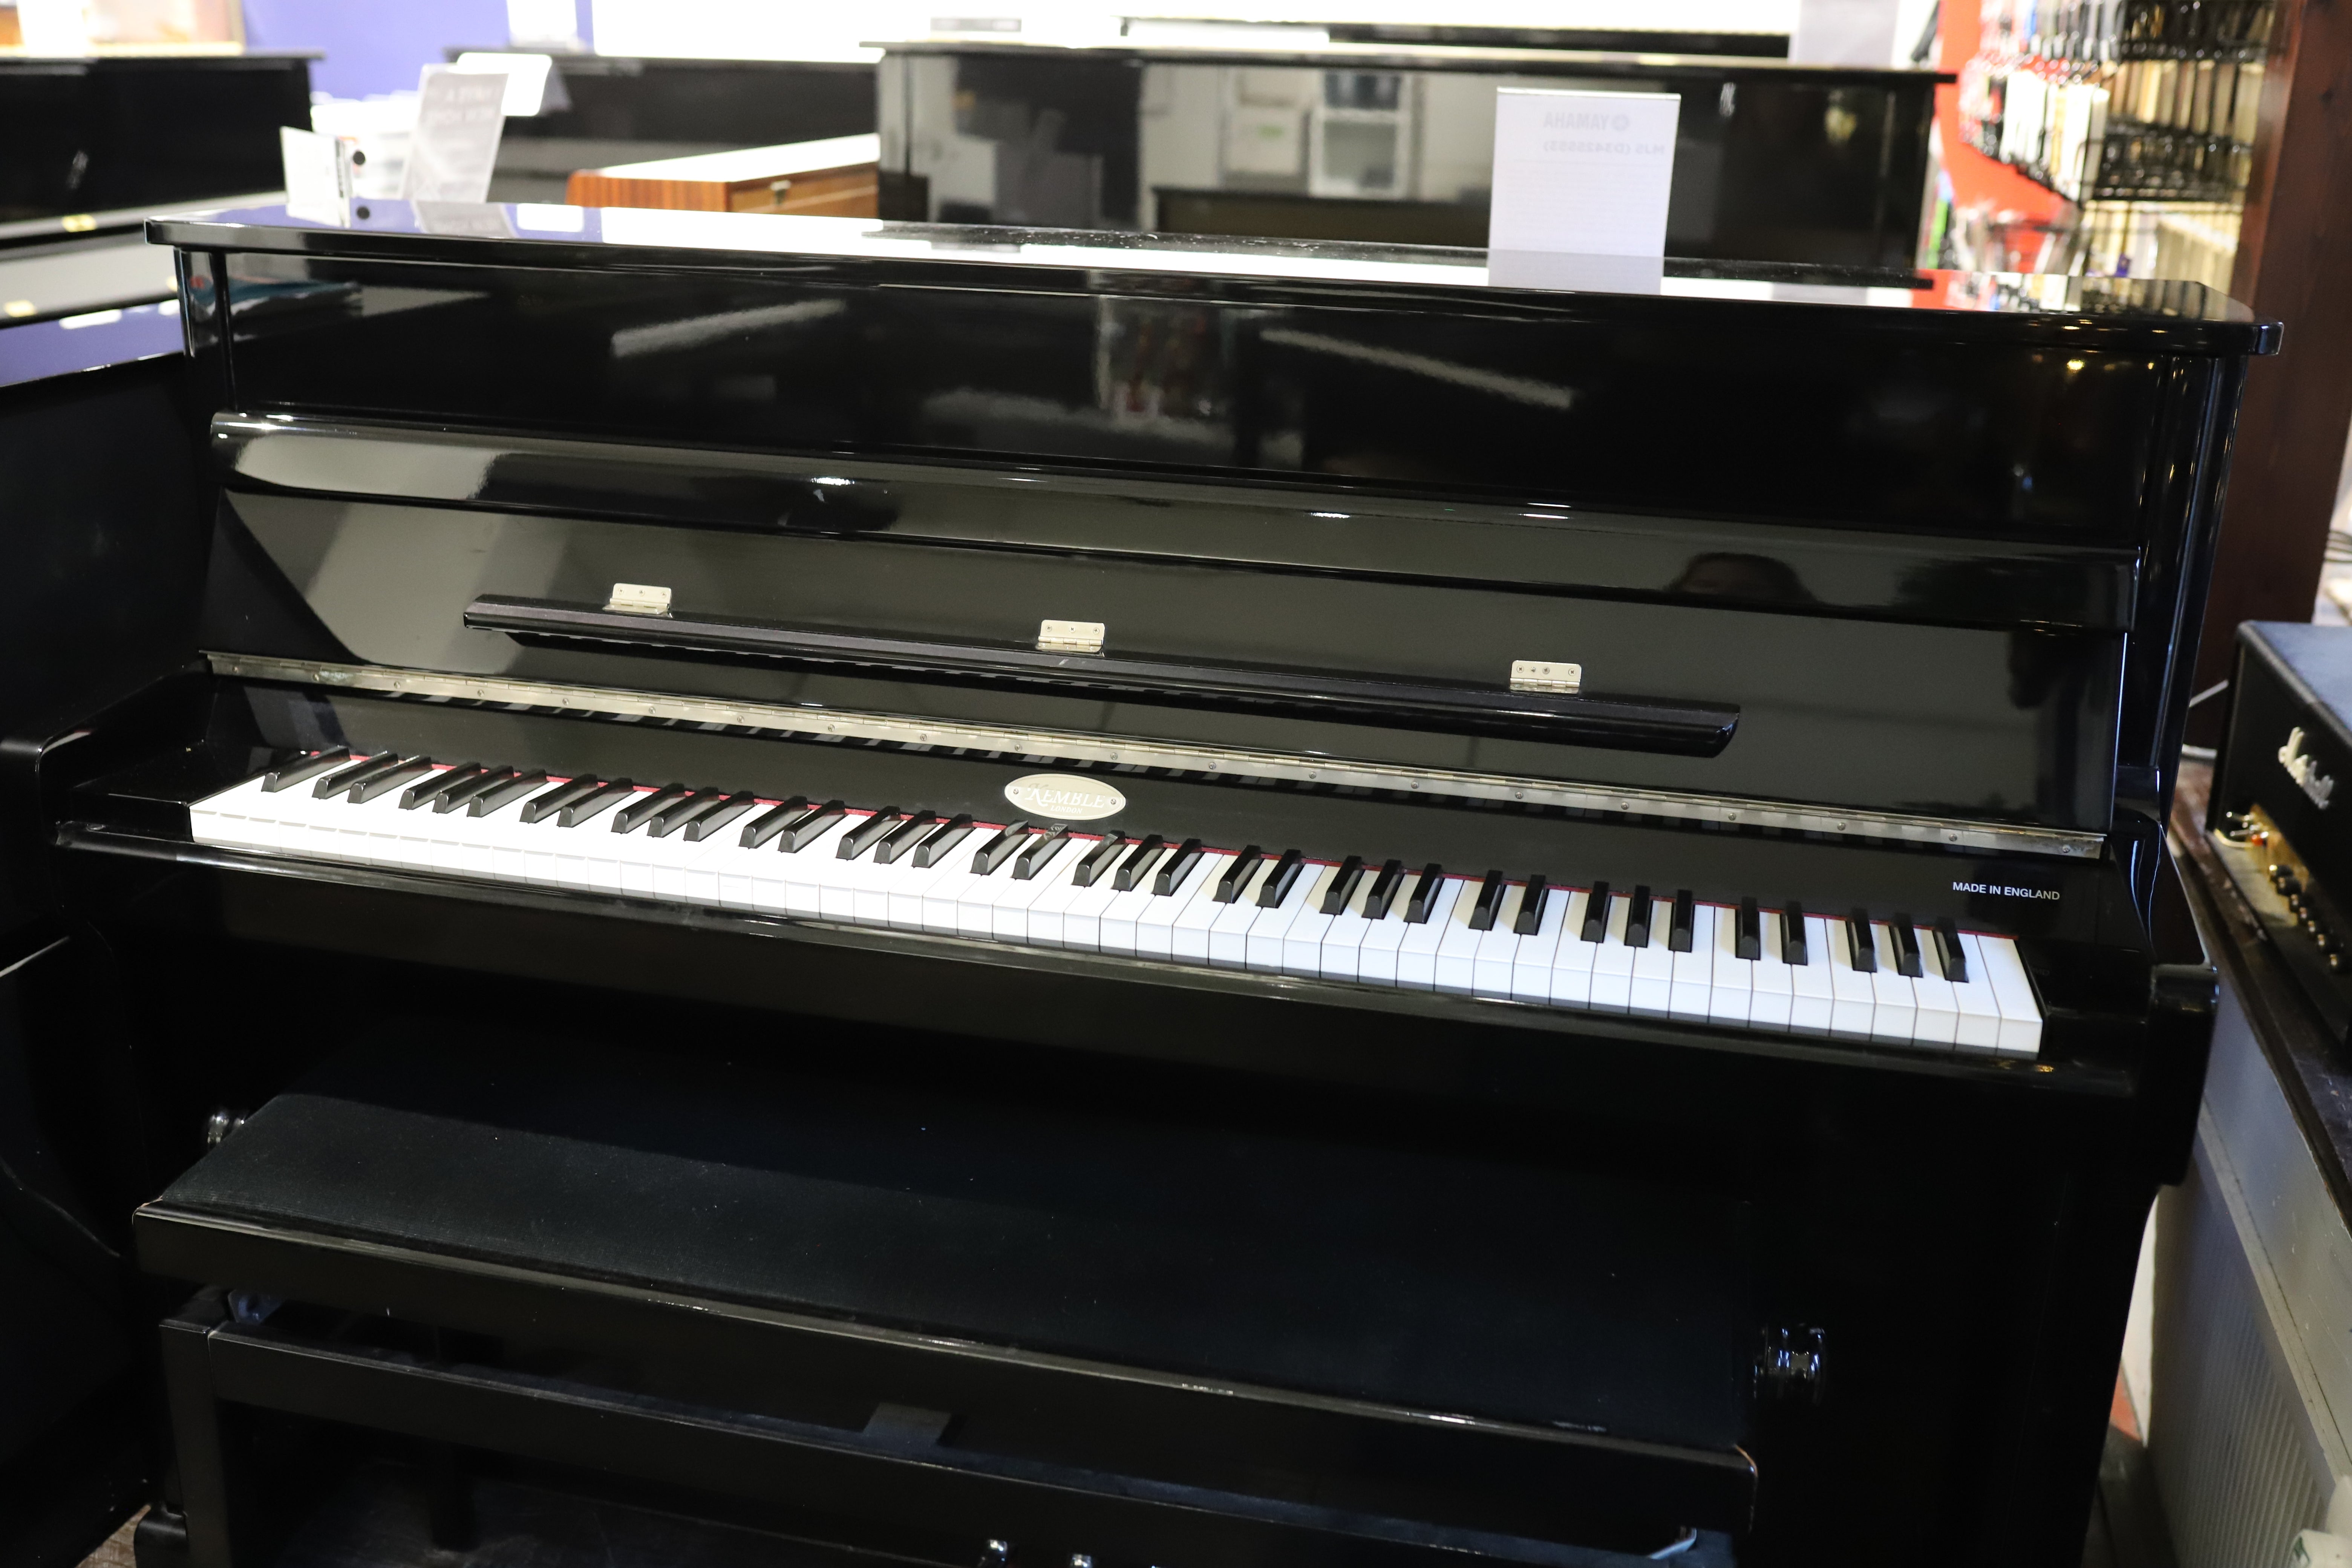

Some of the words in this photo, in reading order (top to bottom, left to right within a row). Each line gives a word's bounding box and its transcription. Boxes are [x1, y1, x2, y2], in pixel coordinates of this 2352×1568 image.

[1025, 783, 1105, 808] KEMBLE
[1050, 805, 1083, 814] LONDON
[1952, 882, 1986, 893] MADE
[1989, 885, 2001, 895] IN
[2004, 887, 2060, 900] ENGLAND
